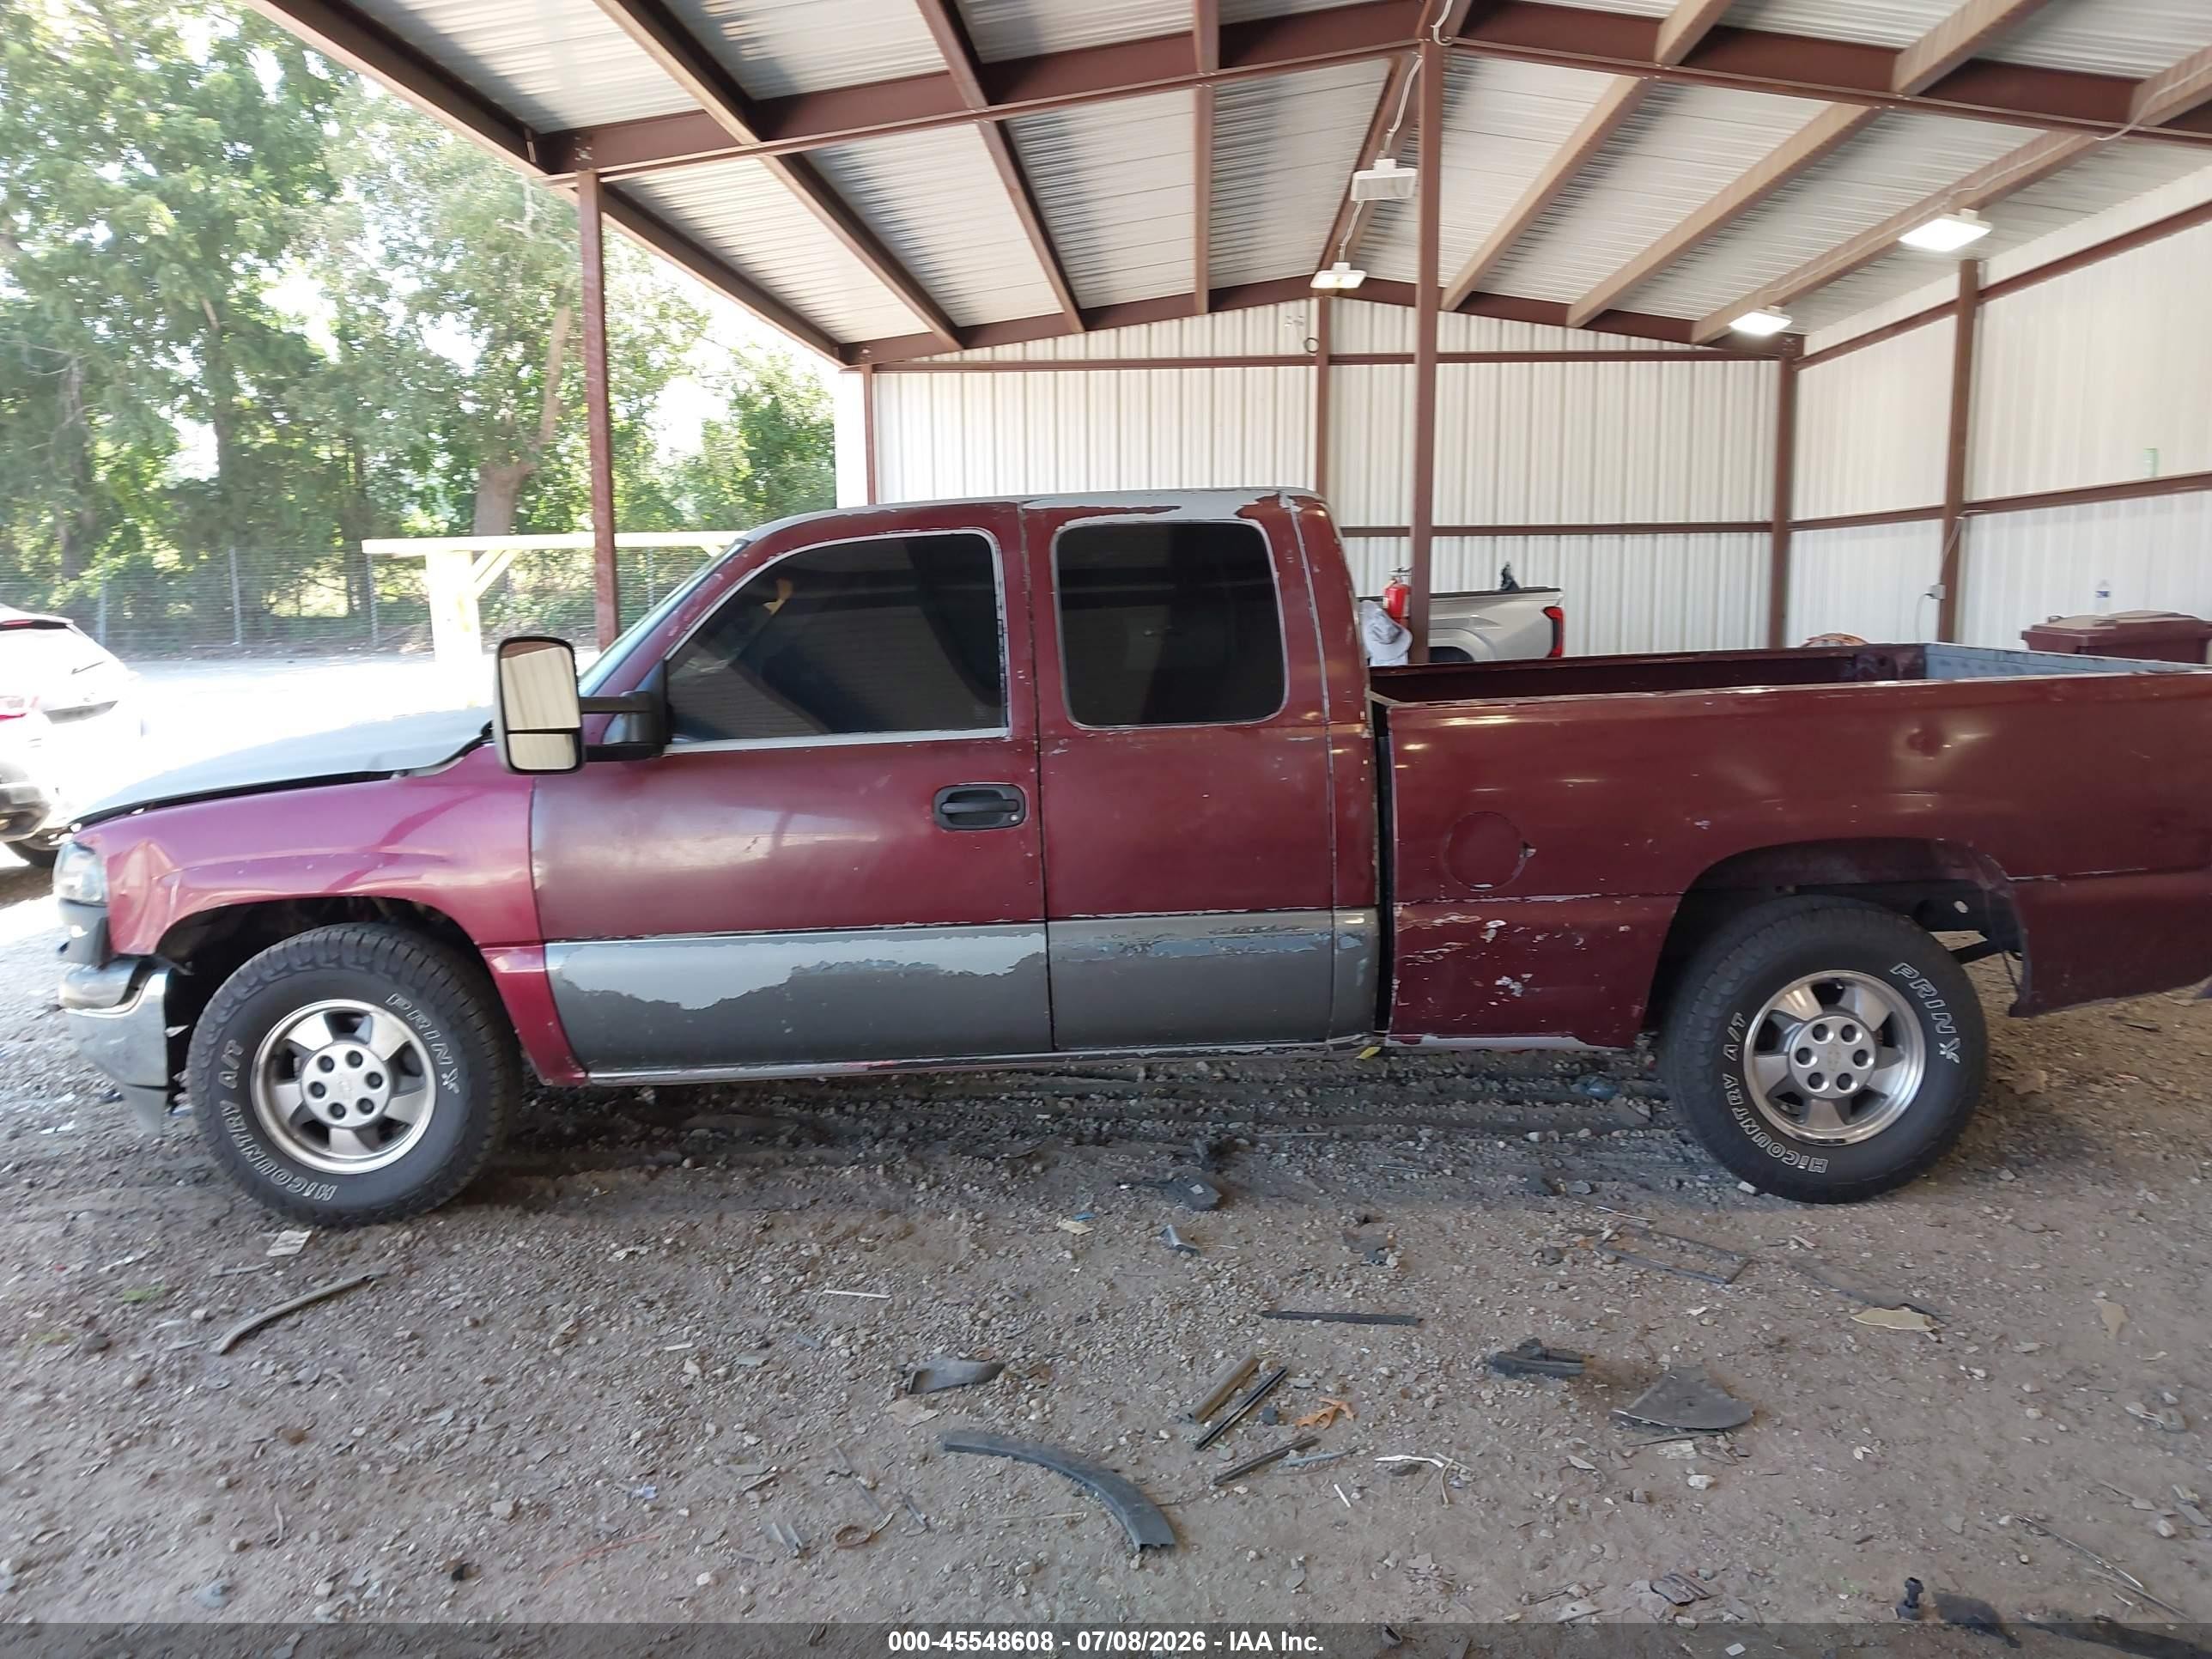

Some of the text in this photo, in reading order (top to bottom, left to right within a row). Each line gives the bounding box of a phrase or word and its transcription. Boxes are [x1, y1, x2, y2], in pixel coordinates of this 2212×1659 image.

[386, 993, 461, 1095] PRINX
[1722, 1012, 1747, 1062] A/T
[1890, 963, 1961, 1065] PRINX
[217, 1039, 245, 1090] A/T
